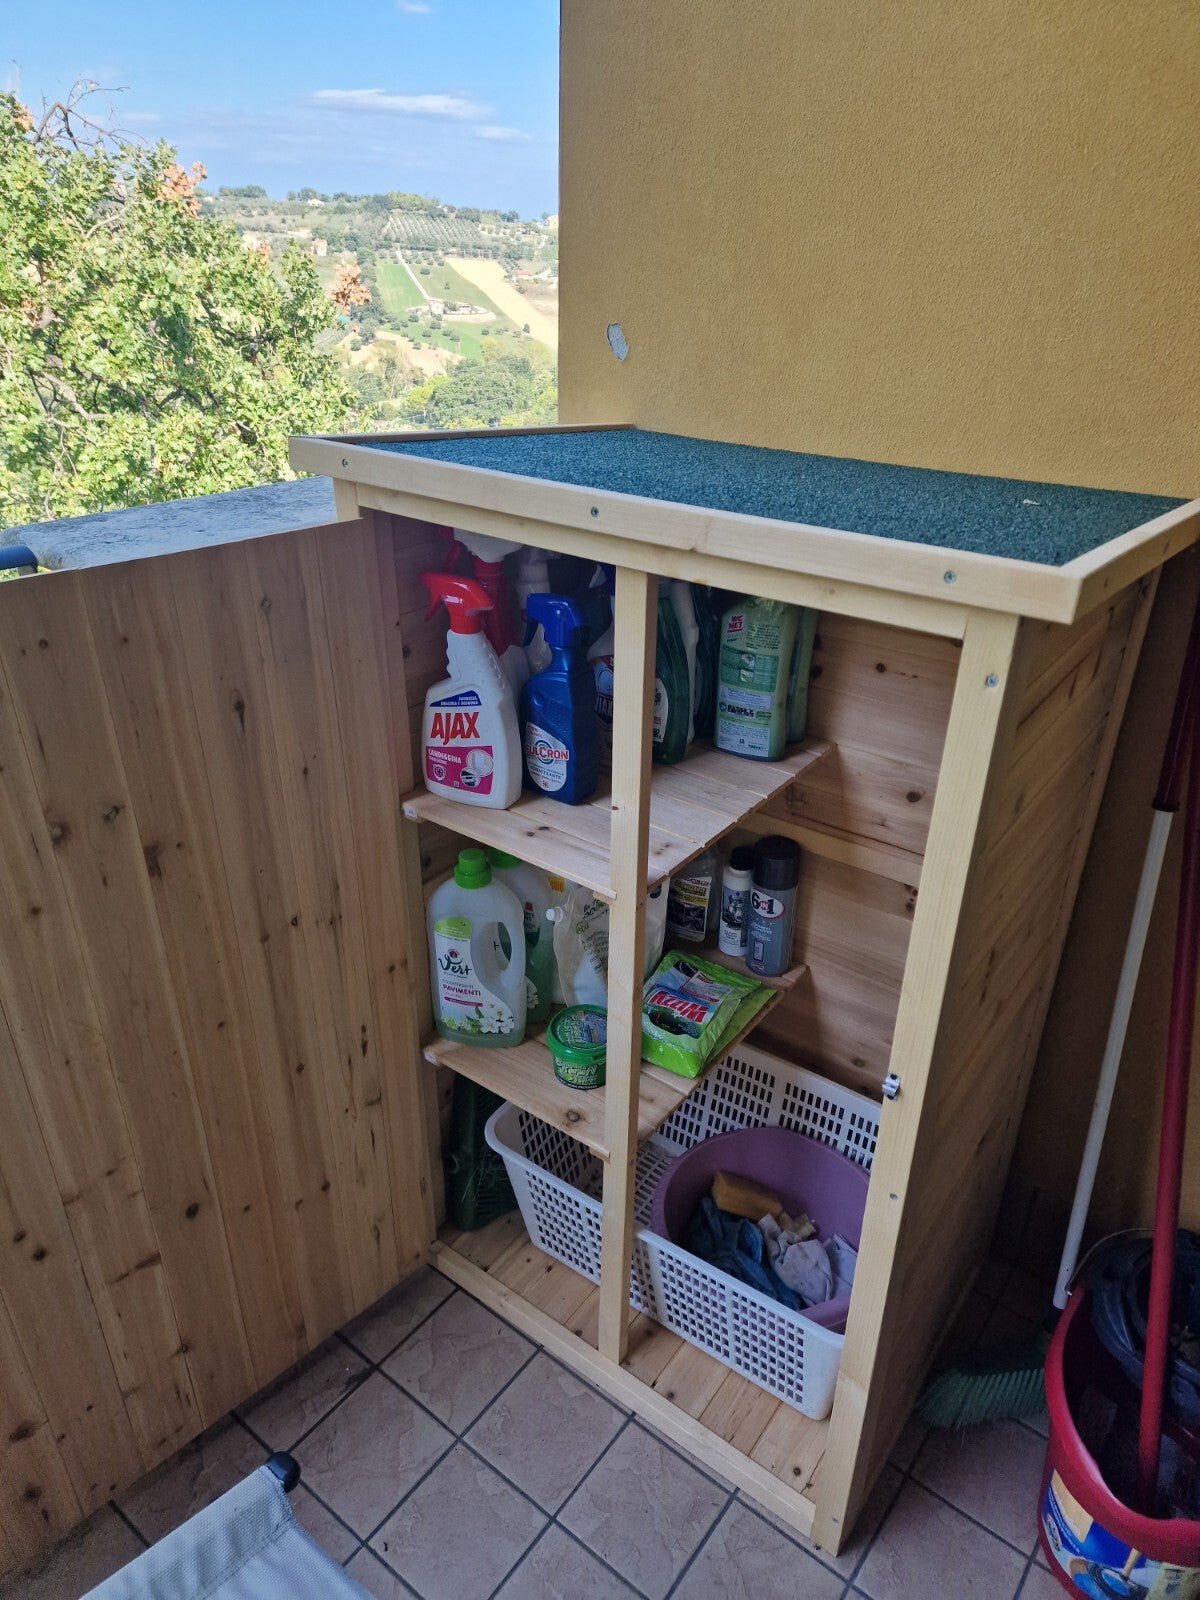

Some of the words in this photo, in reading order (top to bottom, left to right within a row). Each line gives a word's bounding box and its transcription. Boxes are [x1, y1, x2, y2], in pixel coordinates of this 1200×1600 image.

[731, 614, 744, 622] WC
[728, 621, 743, 630] NET
[430, 712, 480, 745] AJAX
[428, 748, 462, 764] CANDEGGINA
[438, 954, 472, 975] Vert
[442, 984, 481, 996] PAVIMENTI
